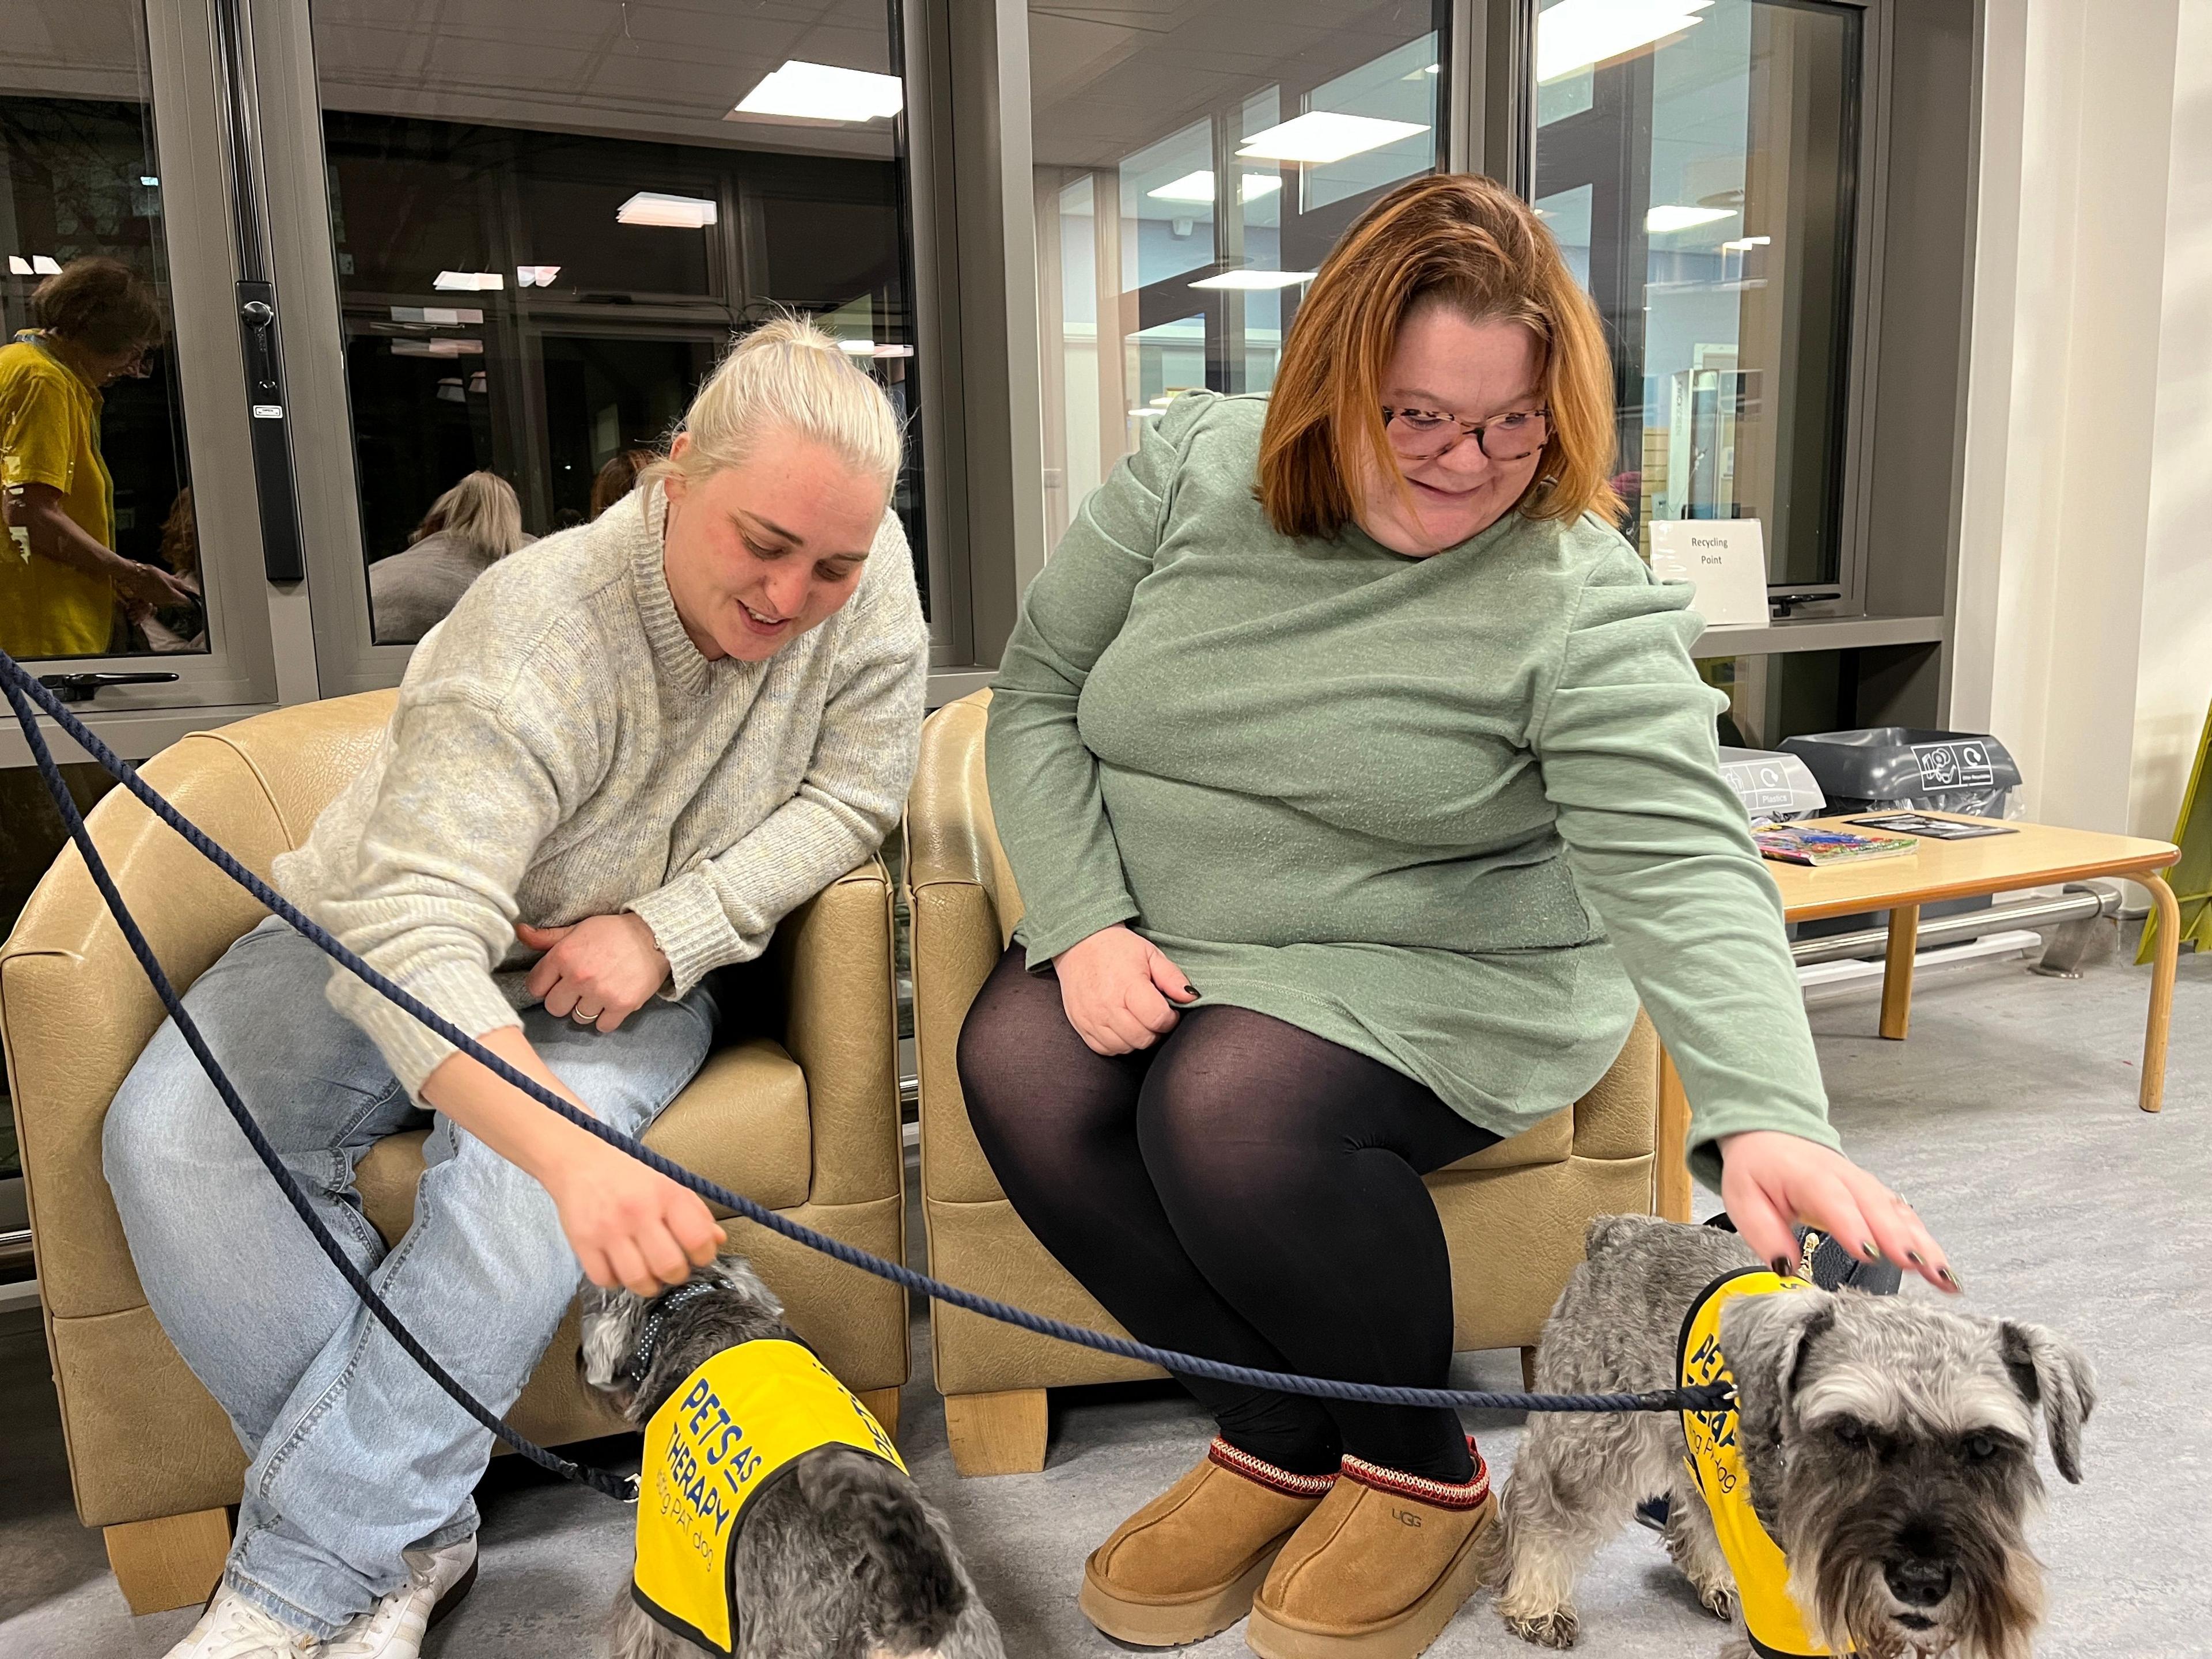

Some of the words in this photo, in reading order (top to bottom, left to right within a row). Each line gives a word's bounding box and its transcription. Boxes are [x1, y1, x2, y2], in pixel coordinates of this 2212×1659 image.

[1691, 537, 1728, 548] Recycling
[1701, 555, 1722, 565] Point
[1762, 794, 1787, 804] Plastics
[680, 1378, 743, 1465] PETS
[730, 1445, 762, 1483] AS
[665, 1421, 730, 1537] THERAPY
[1391, 1508, 1422, 1528] UGG
[692, 1530, 714, 1573] dog
